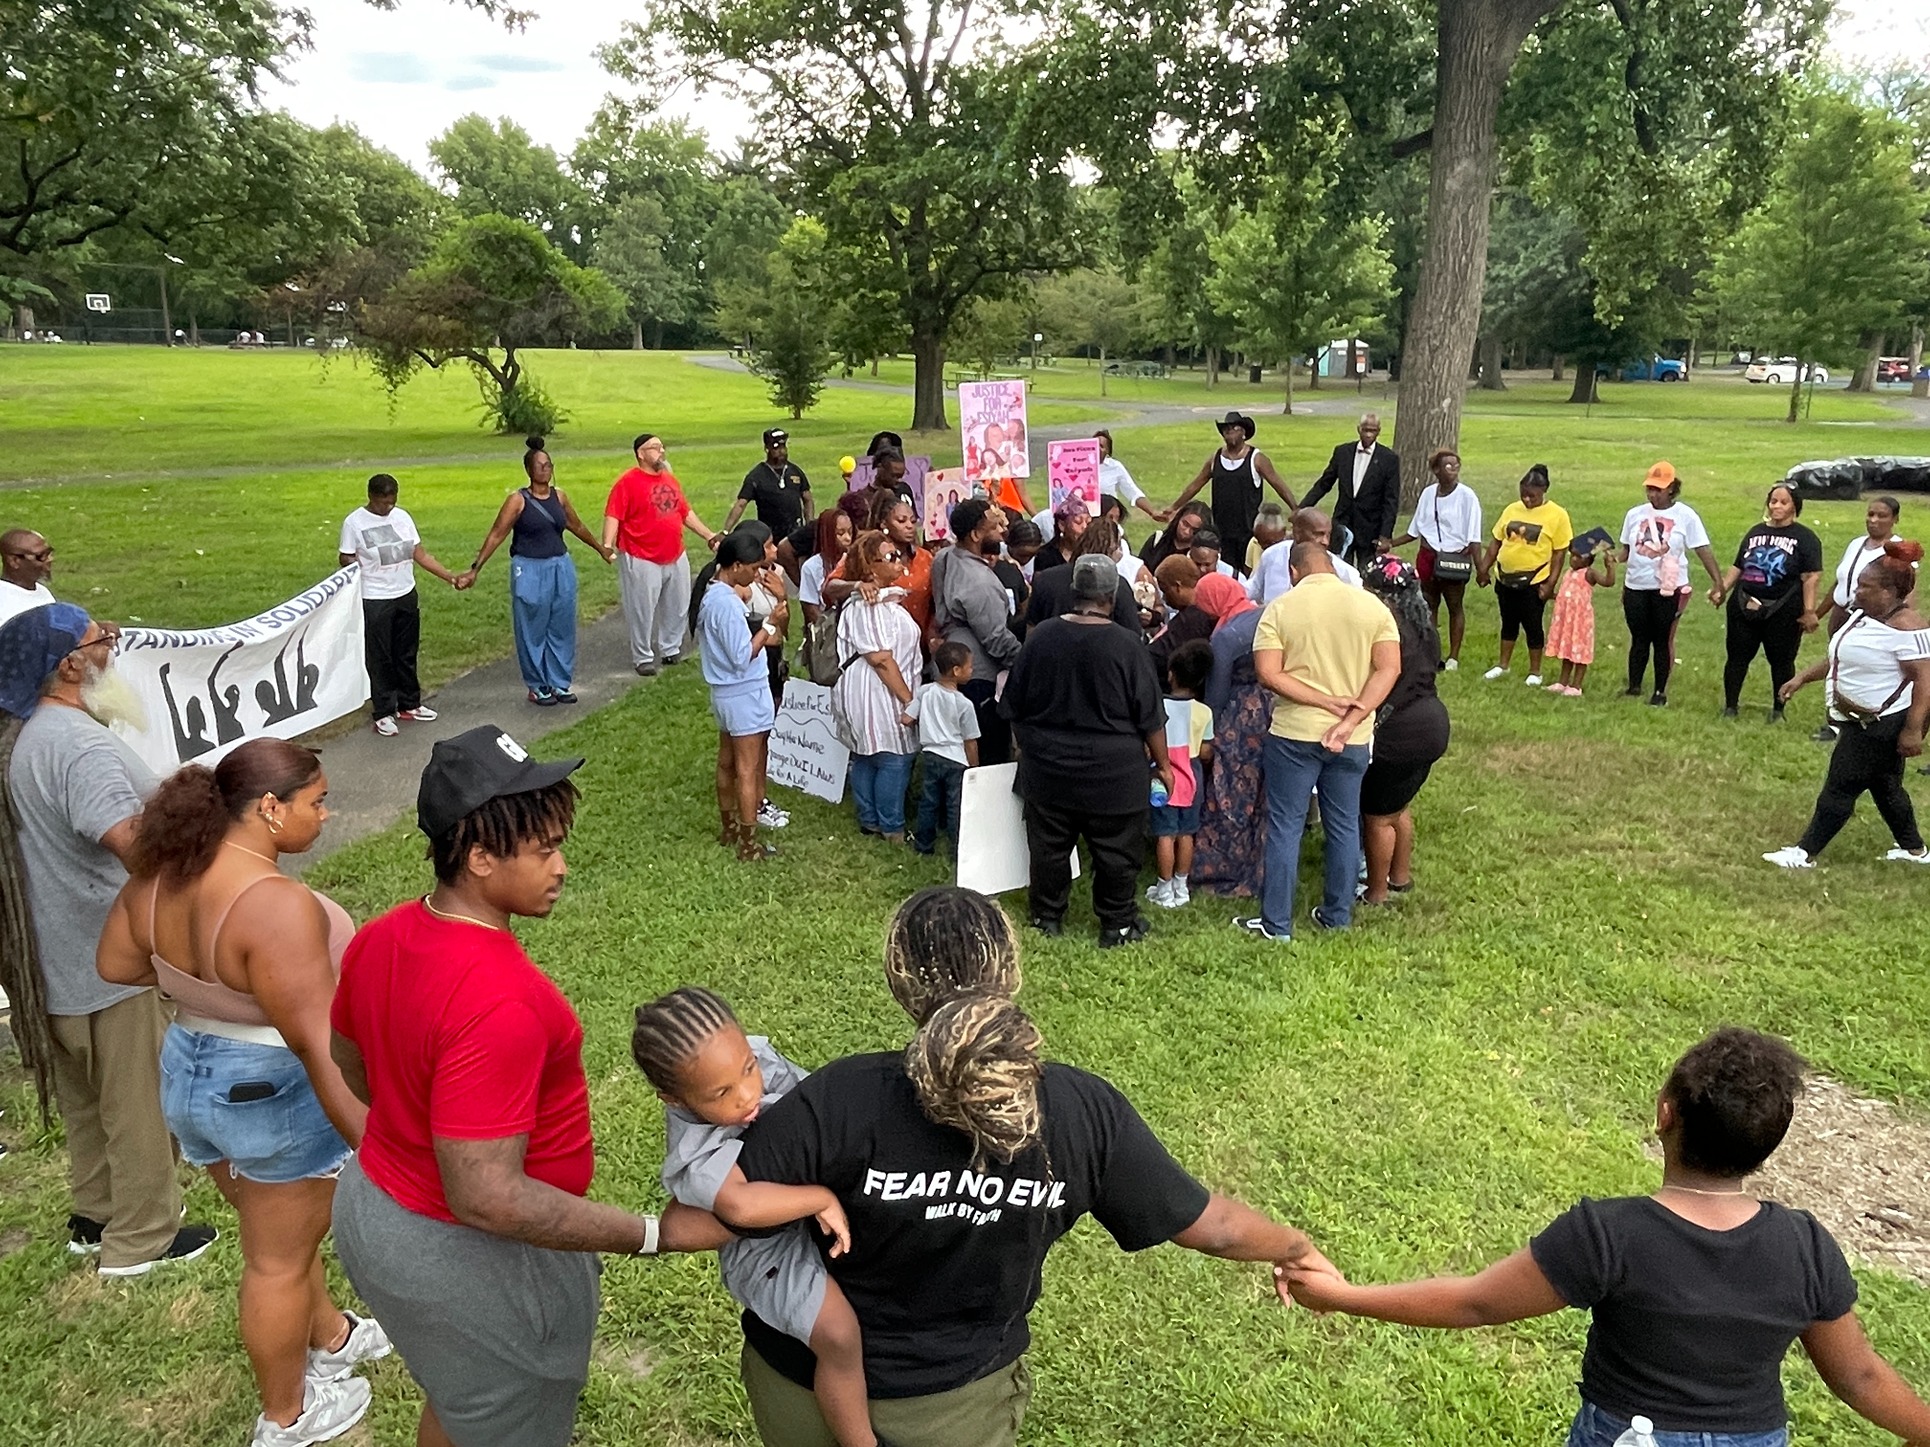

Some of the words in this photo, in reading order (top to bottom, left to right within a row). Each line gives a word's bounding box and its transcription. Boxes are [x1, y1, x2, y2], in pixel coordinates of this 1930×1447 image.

[972, 383, 1012, 398] JUSTICE
[256, 564, 359, 630] SOLIDARIT
[863, 1168, 951, 1201] FEAR
[955, 1169, 1004, 1206] NO
[1006, 1178, 1066, 1209] EVIL
[925, 1202, 957, 1220] WALK
[957, 1203, 975, 1219] BY
